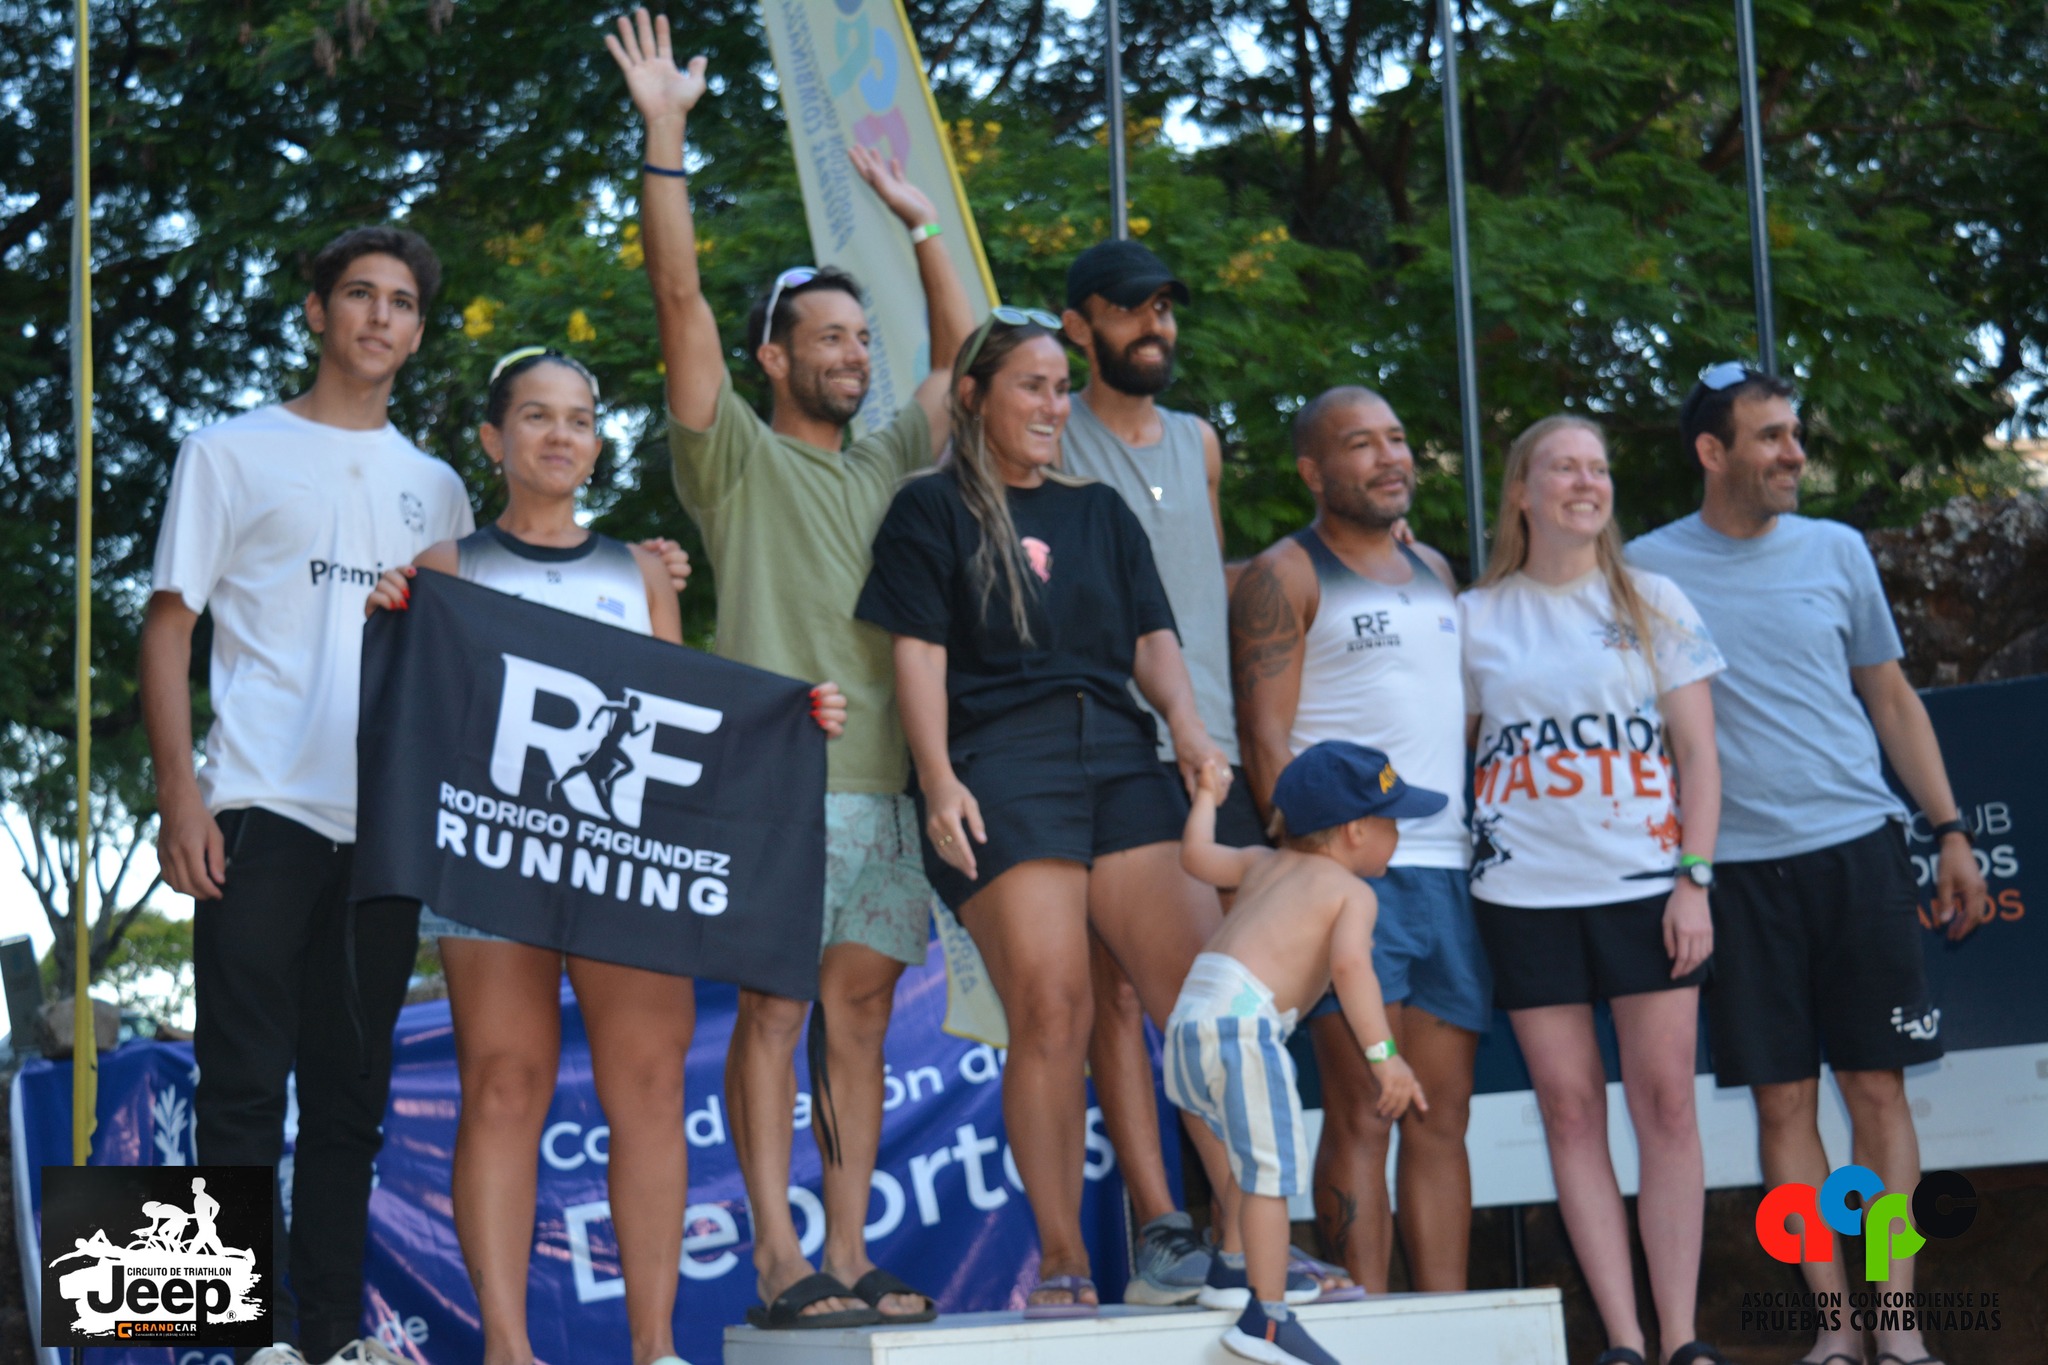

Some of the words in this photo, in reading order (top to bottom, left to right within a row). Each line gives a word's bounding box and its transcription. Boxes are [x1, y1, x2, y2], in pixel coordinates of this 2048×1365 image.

[489, 652, 724, 829] RF
[435, 807, 730, 917] RUNNING
[439, 780, 570, 839] RODRIGO
[576, 819, 731, 877] FAGUNDEZ
